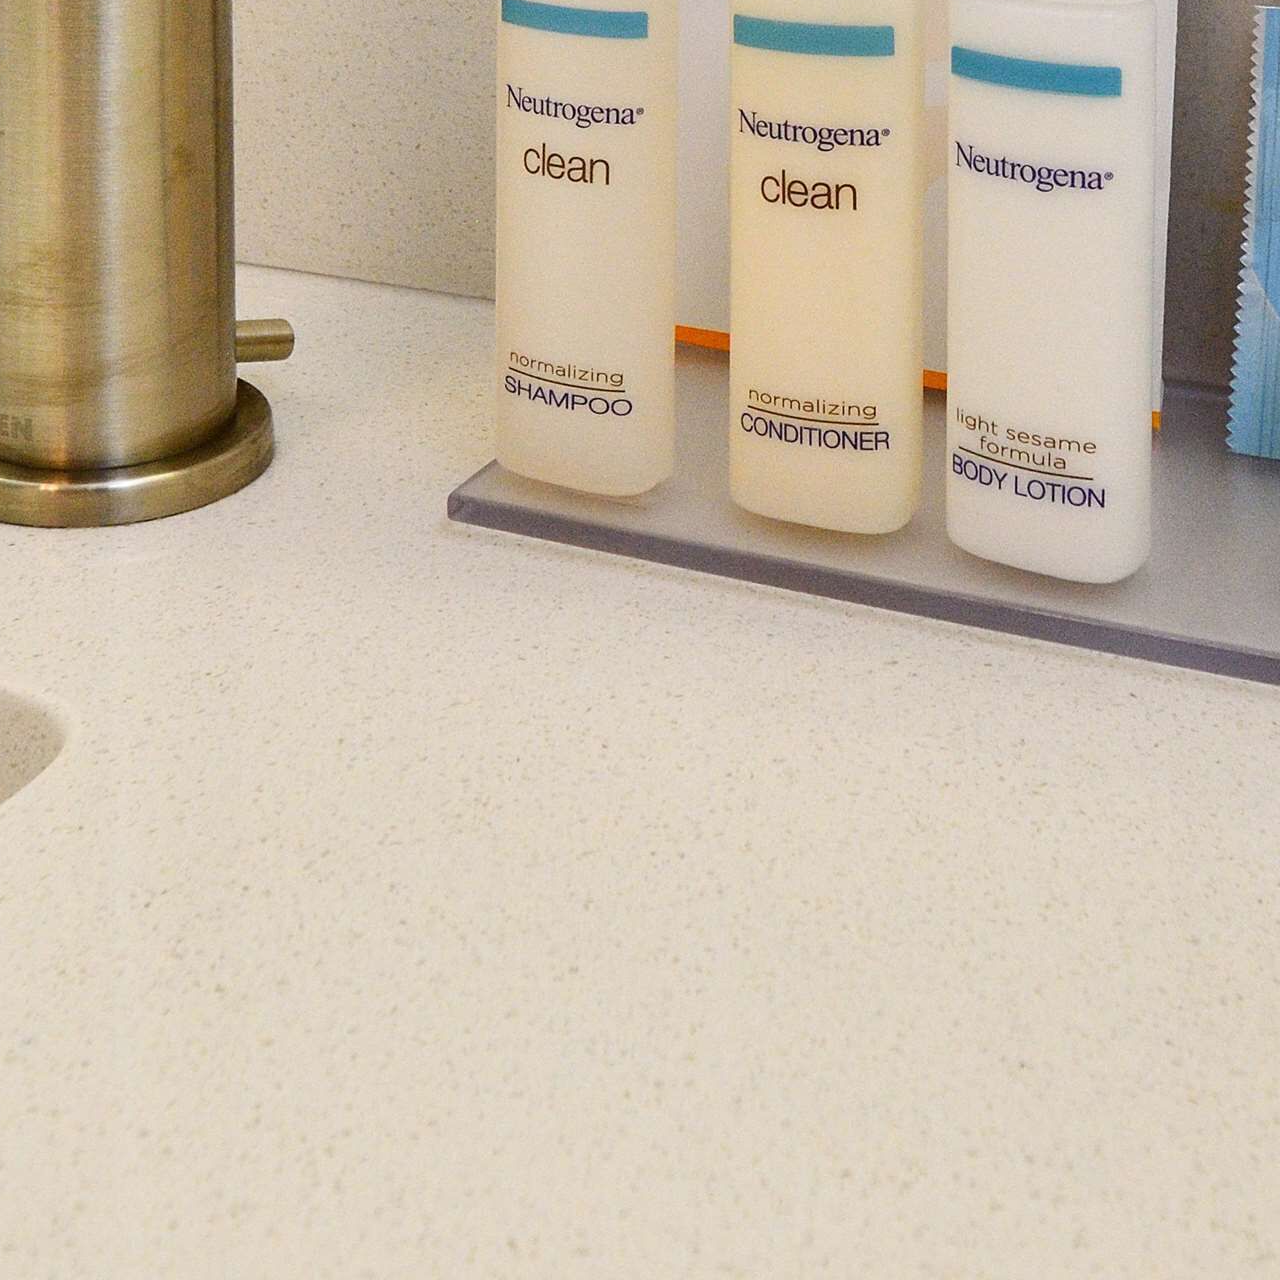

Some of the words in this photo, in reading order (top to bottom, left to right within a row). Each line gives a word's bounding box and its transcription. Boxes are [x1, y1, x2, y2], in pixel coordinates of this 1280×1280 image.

[523, 142, 610, 186] clean
[761, 169, 858, 211] clean
[510, 351, 624, 387] normalizing
[504, 375, 633, 416] SHAMPOO
[748, 388, 878, 420] normalizing
[740, 412, 890, 451] CONDITIONER
[956, 407, 998, 436] light
[1006, 426, 1097, 454] sesame
[980, 435, 1066, 470] formula
[952, 453, 1008, 490] BODY
[1014, 475, 1106, 508] LOTION
